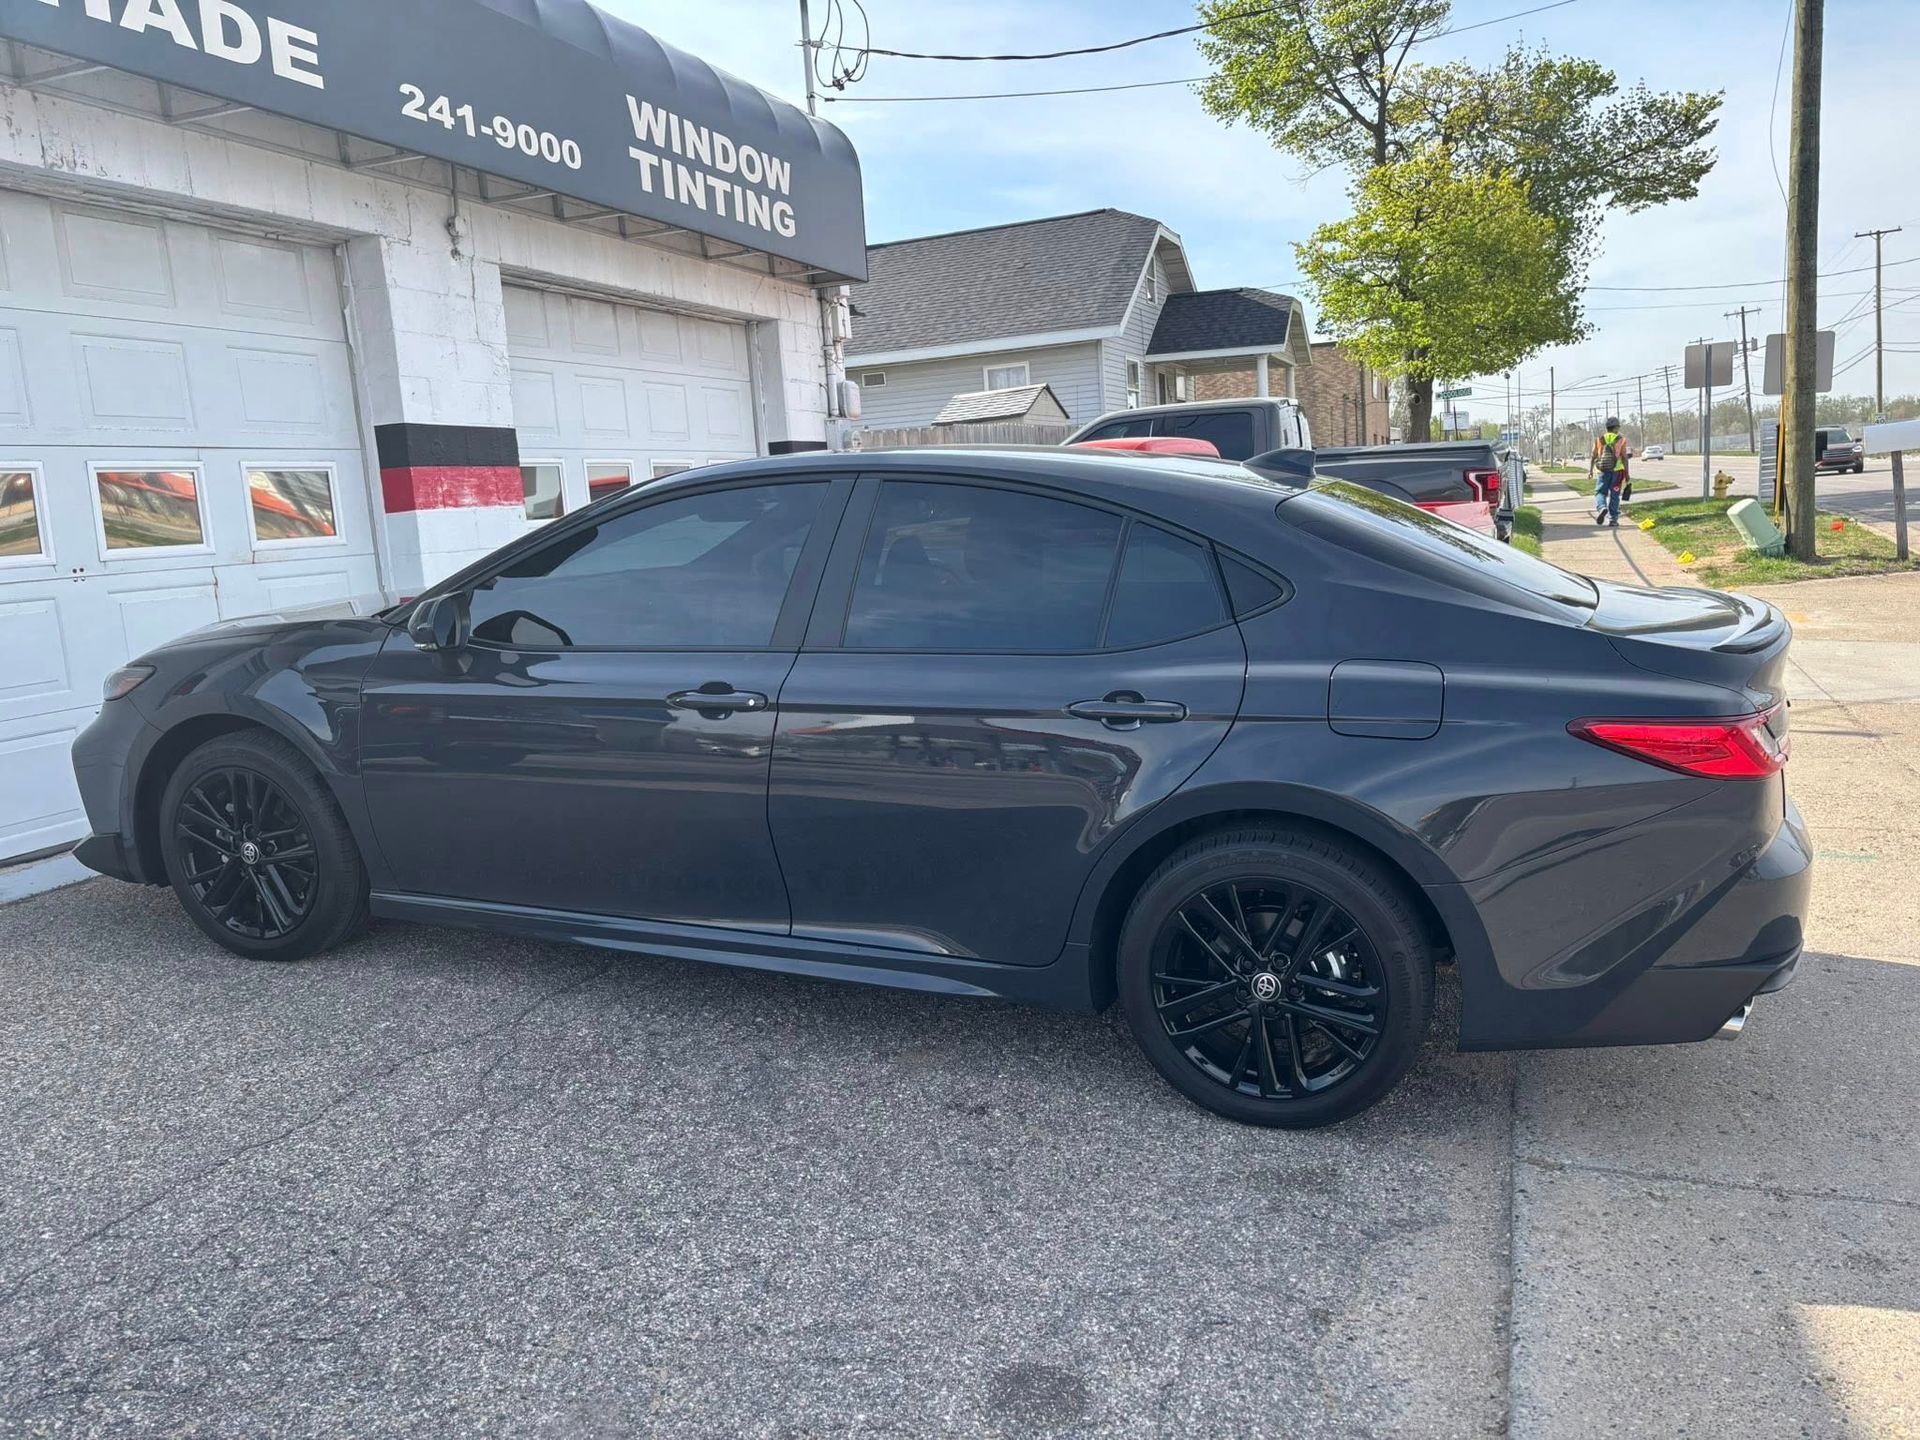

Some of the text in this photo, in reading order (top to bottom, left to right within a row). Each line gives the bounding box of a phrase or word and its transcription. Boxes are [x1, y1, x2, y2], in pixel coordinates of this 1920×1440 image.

[40, 0, 325, 89] ADE
[399, 83, 582, 170] 241-9000
[626, 94, 791, 195] WINDOW
[629, 146, 796, 238] TINTING
